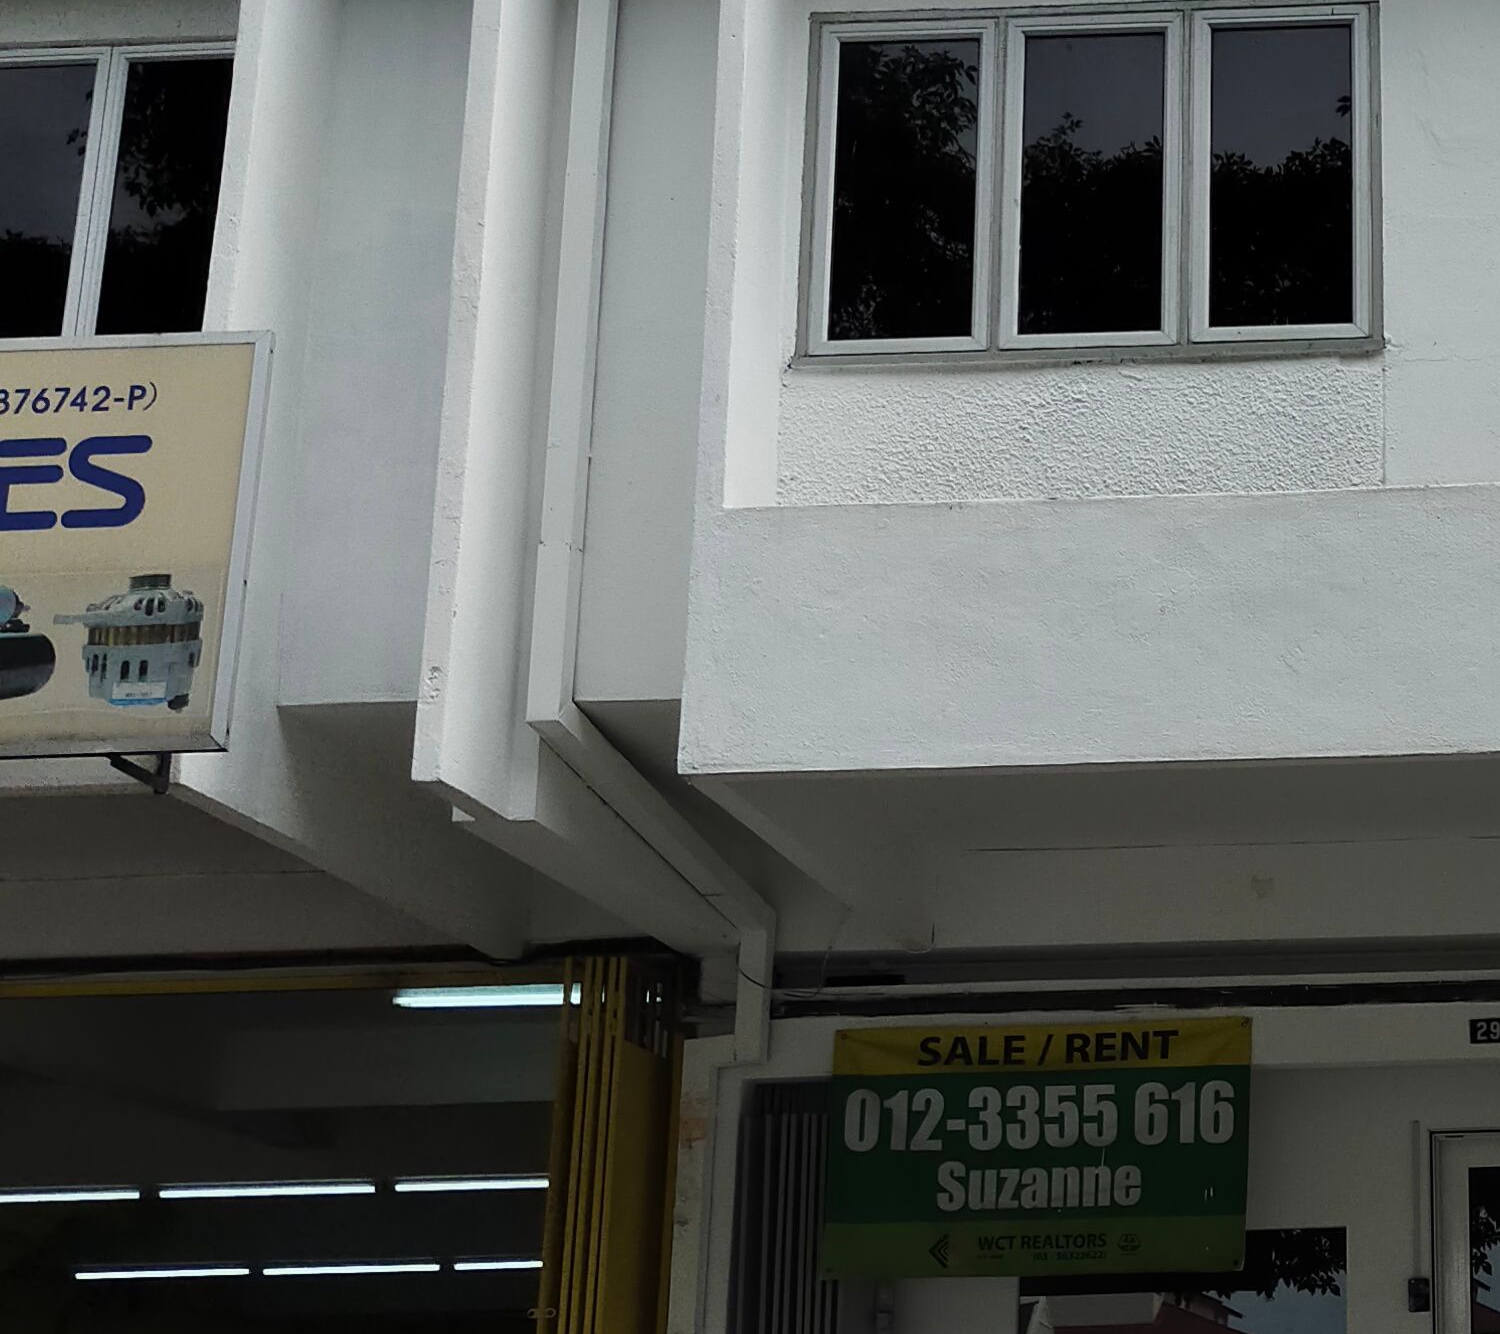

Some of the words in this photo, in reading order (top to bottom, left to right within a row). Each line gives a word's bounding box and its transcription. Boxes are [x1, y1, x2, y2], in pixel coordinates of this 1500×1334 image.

[0, 434, 153, 530] ES
[918, 1035, 1025, 1066] SALE
[1038, 1034, 1053, 1066] /
[1066, 1030, 1179, 1064] RENT
[1476, 1021, 1500, 1040] 29
[844, 1084, 1118, 1152] 012-3355
[1134, 1080, 1234, 1144] 616
[936, 1160, 1141, 1211] Suzanne
[979, 1235, 1017, 1251] WCT
[1021, 1233, 1107, 1250] REALTORS
